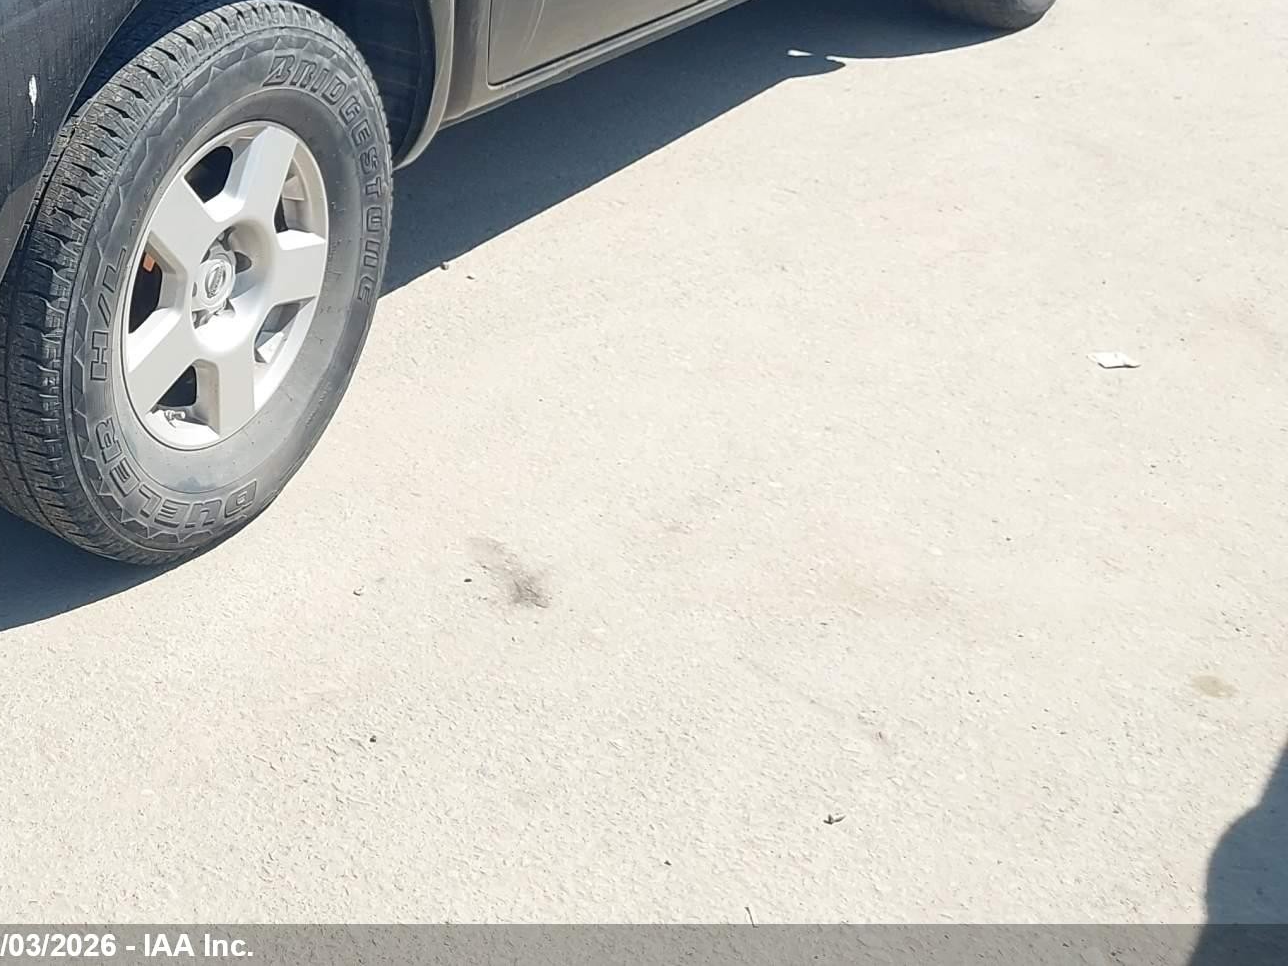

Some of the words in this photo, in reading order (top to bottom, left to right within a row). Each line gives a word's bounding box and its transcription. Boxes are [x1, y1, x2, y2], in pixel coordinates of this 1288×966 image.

[262, 54, 384, 306] BRIDGESTONE
[89, 246, 127, 381] H/L
[96, 414, 259, 529] DUELER
